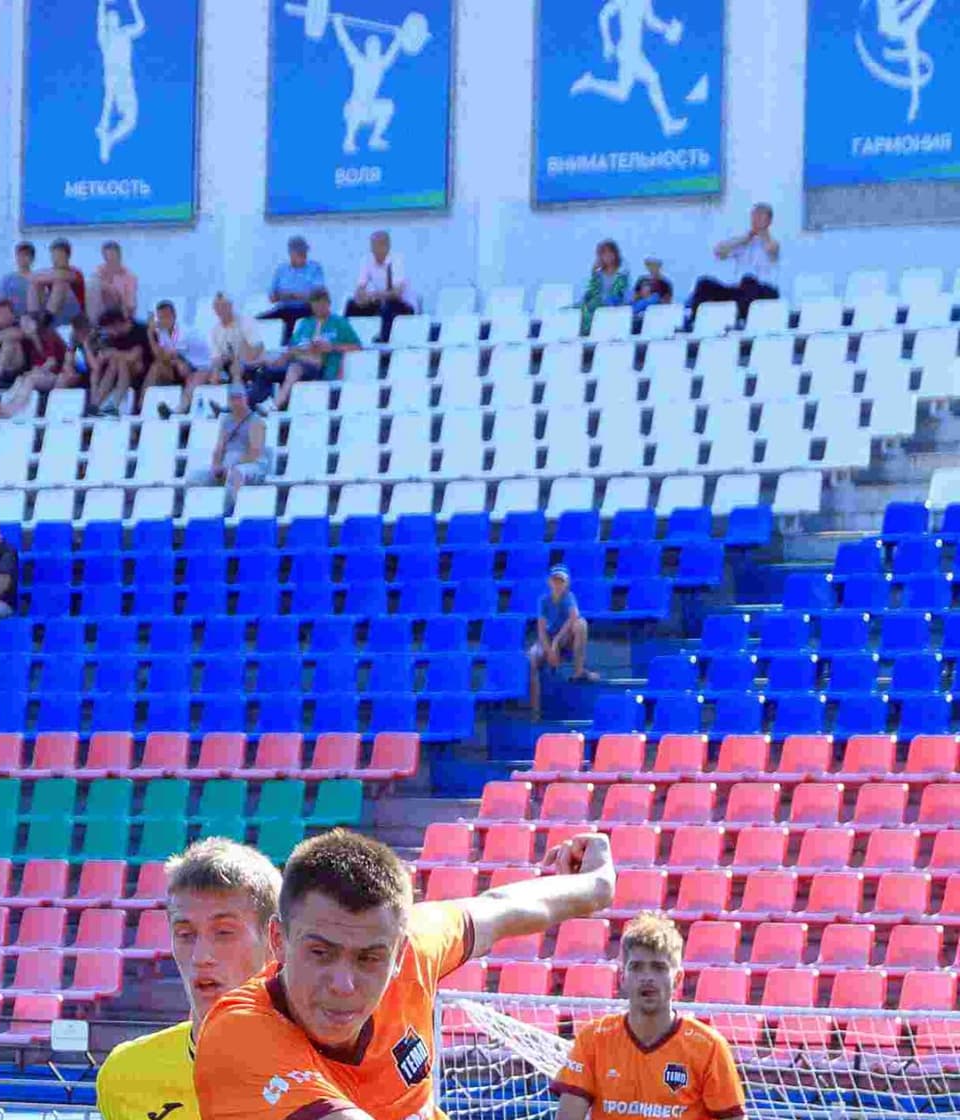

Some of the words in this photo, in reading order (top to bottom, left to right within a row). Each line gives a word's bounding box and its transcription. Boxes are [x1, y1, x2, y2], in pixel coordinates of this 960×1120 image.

[852, 132, 954, 157] ГАРМОНИЯ
[546, 148, 711, 177] ВНИМАТЕЛЬНОСТЬ
[335, 166, 382, 188] ВОЛЯ
[64, 178, 152, 201] МЕТКОСТЬ
